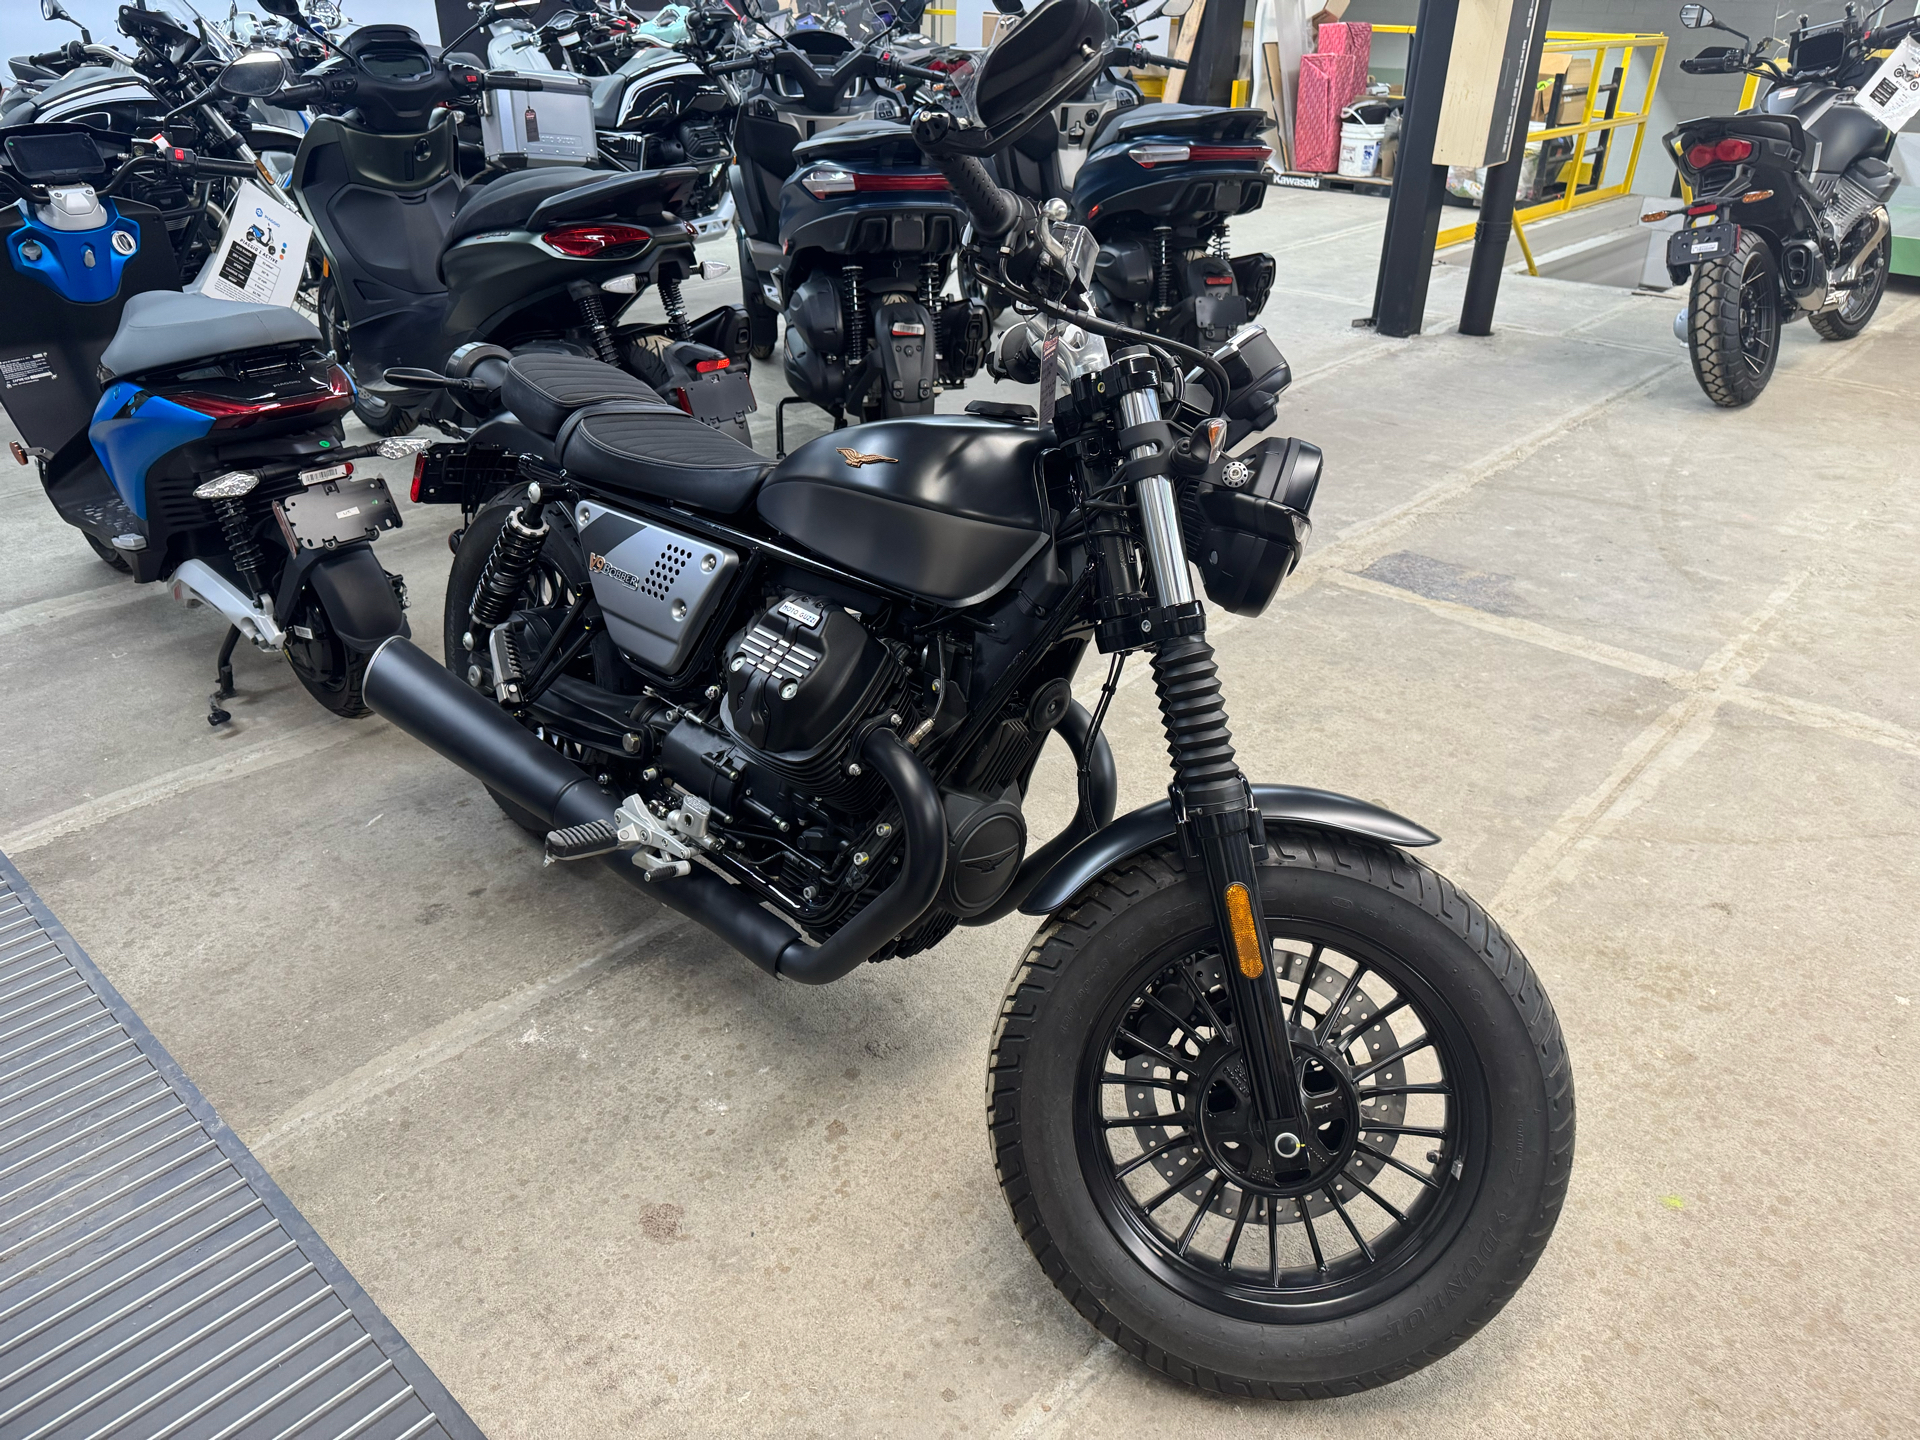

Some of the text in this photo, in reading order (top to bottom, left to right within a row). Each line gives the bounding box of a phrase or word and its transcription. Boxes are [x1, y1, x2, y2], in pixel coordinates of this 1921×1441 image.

[1273, 174, 1320, 189] Kawasaki
[240, 238, 258, 252] PIAGGIO
[262, 252, 278, 263] ACTIVE
[589, 552, 638, 586] V9 BOBBER
[781, 604, 817, 624] MOTO GUZZI
[1381, 1226, 1501, 1346] DUNLOP
